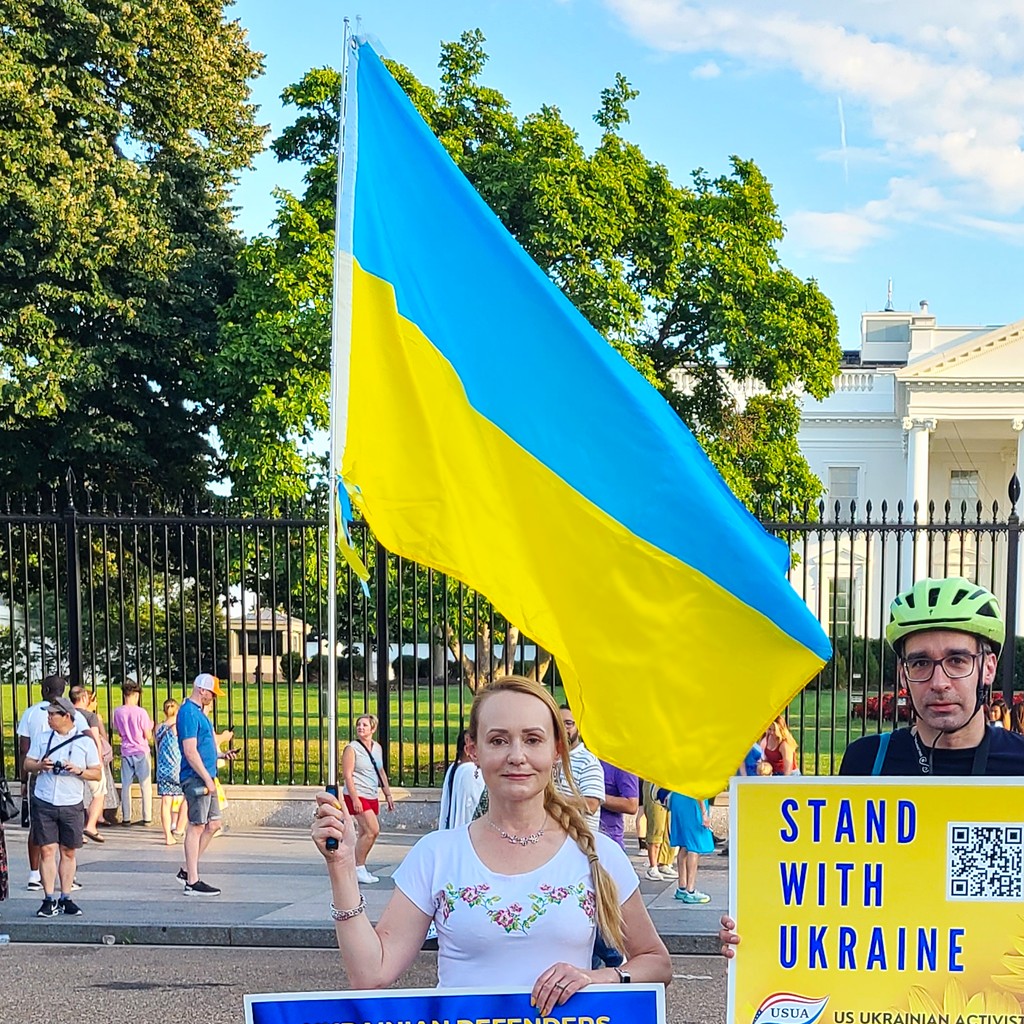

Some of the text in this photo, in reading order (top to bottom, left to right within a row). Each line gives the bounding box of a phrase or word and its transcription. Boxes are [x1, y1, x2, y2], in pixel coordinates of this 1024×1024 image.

[780, 798, 917, 844] STAND
[780, 861, 883, 907] WITH
[780, 925, 966, 972] UKRAINE
[770, 1007, 810, 1020] USUA
[833, 1011, 854, 1024] US
